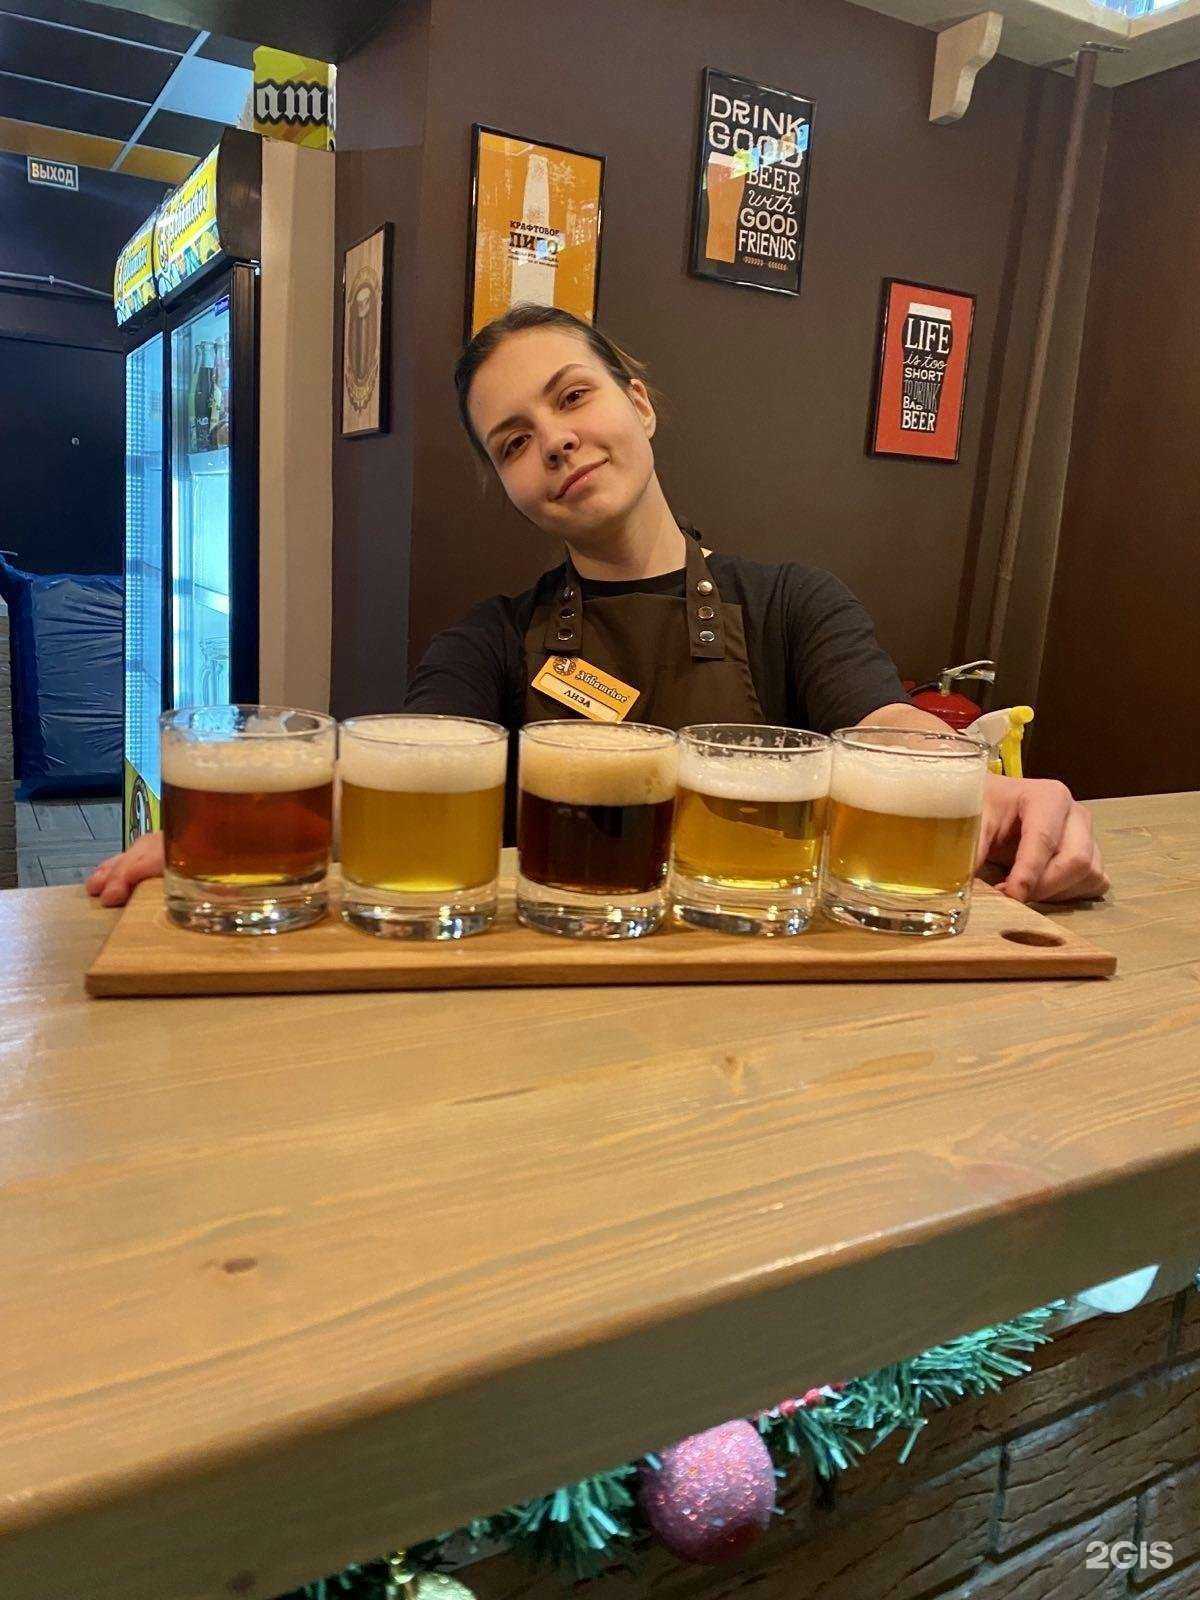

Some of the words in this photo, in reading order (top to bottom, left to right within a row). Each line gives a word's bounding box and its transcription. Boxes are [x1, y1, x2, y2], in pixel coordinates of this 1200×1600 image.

[710, 93, 806, 136] DRINK
[31, 162, 74, 187] ВЫХОД
[746, 164, 800, 196] BEER
[748, 189, 796, 215] with
[509, 220, 560, 237] КРАФТОВОЕ
[740, 207, 798, 236] GOOD
[738, 229, 797, 261] FRIENDS
[904, 317, 951, 354] LIFE
[903, 352, 920, 366] is
[920, 354, 948, 370] too
[904, 367, 944, 382] SHORT
[902, 395, 924, 410] BAD
[901, 409, 936, 431] BEER
[563, 689, 592, 708] ЛИЗА
